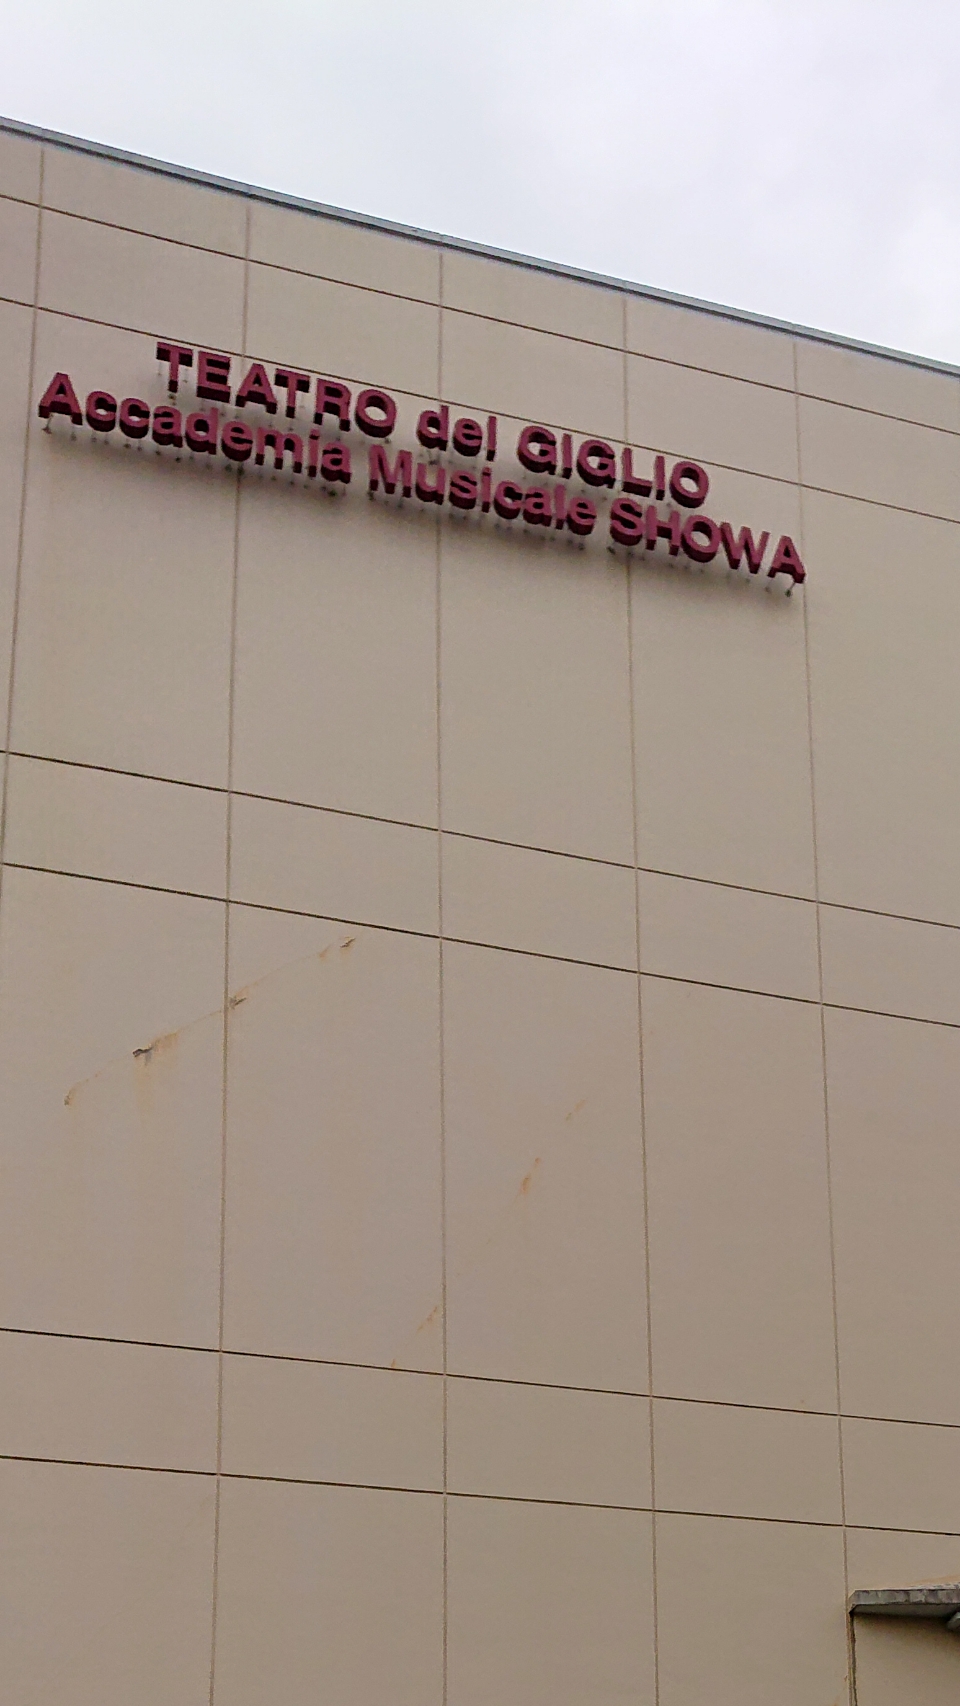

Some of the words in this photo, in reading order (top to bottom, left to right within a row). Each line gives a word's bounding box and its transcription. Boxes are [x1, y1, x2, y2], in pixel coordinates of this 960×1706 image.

[38, 372, 351, 484] Accademia
[368, 444, 597, 536] Musicale
[609, 497, 806, 584] SHOWA
[156, 341, 397, 438] TEATRO
[416, 404, 497, 461] del
[517, 425, 709, 508] GIGLIO
